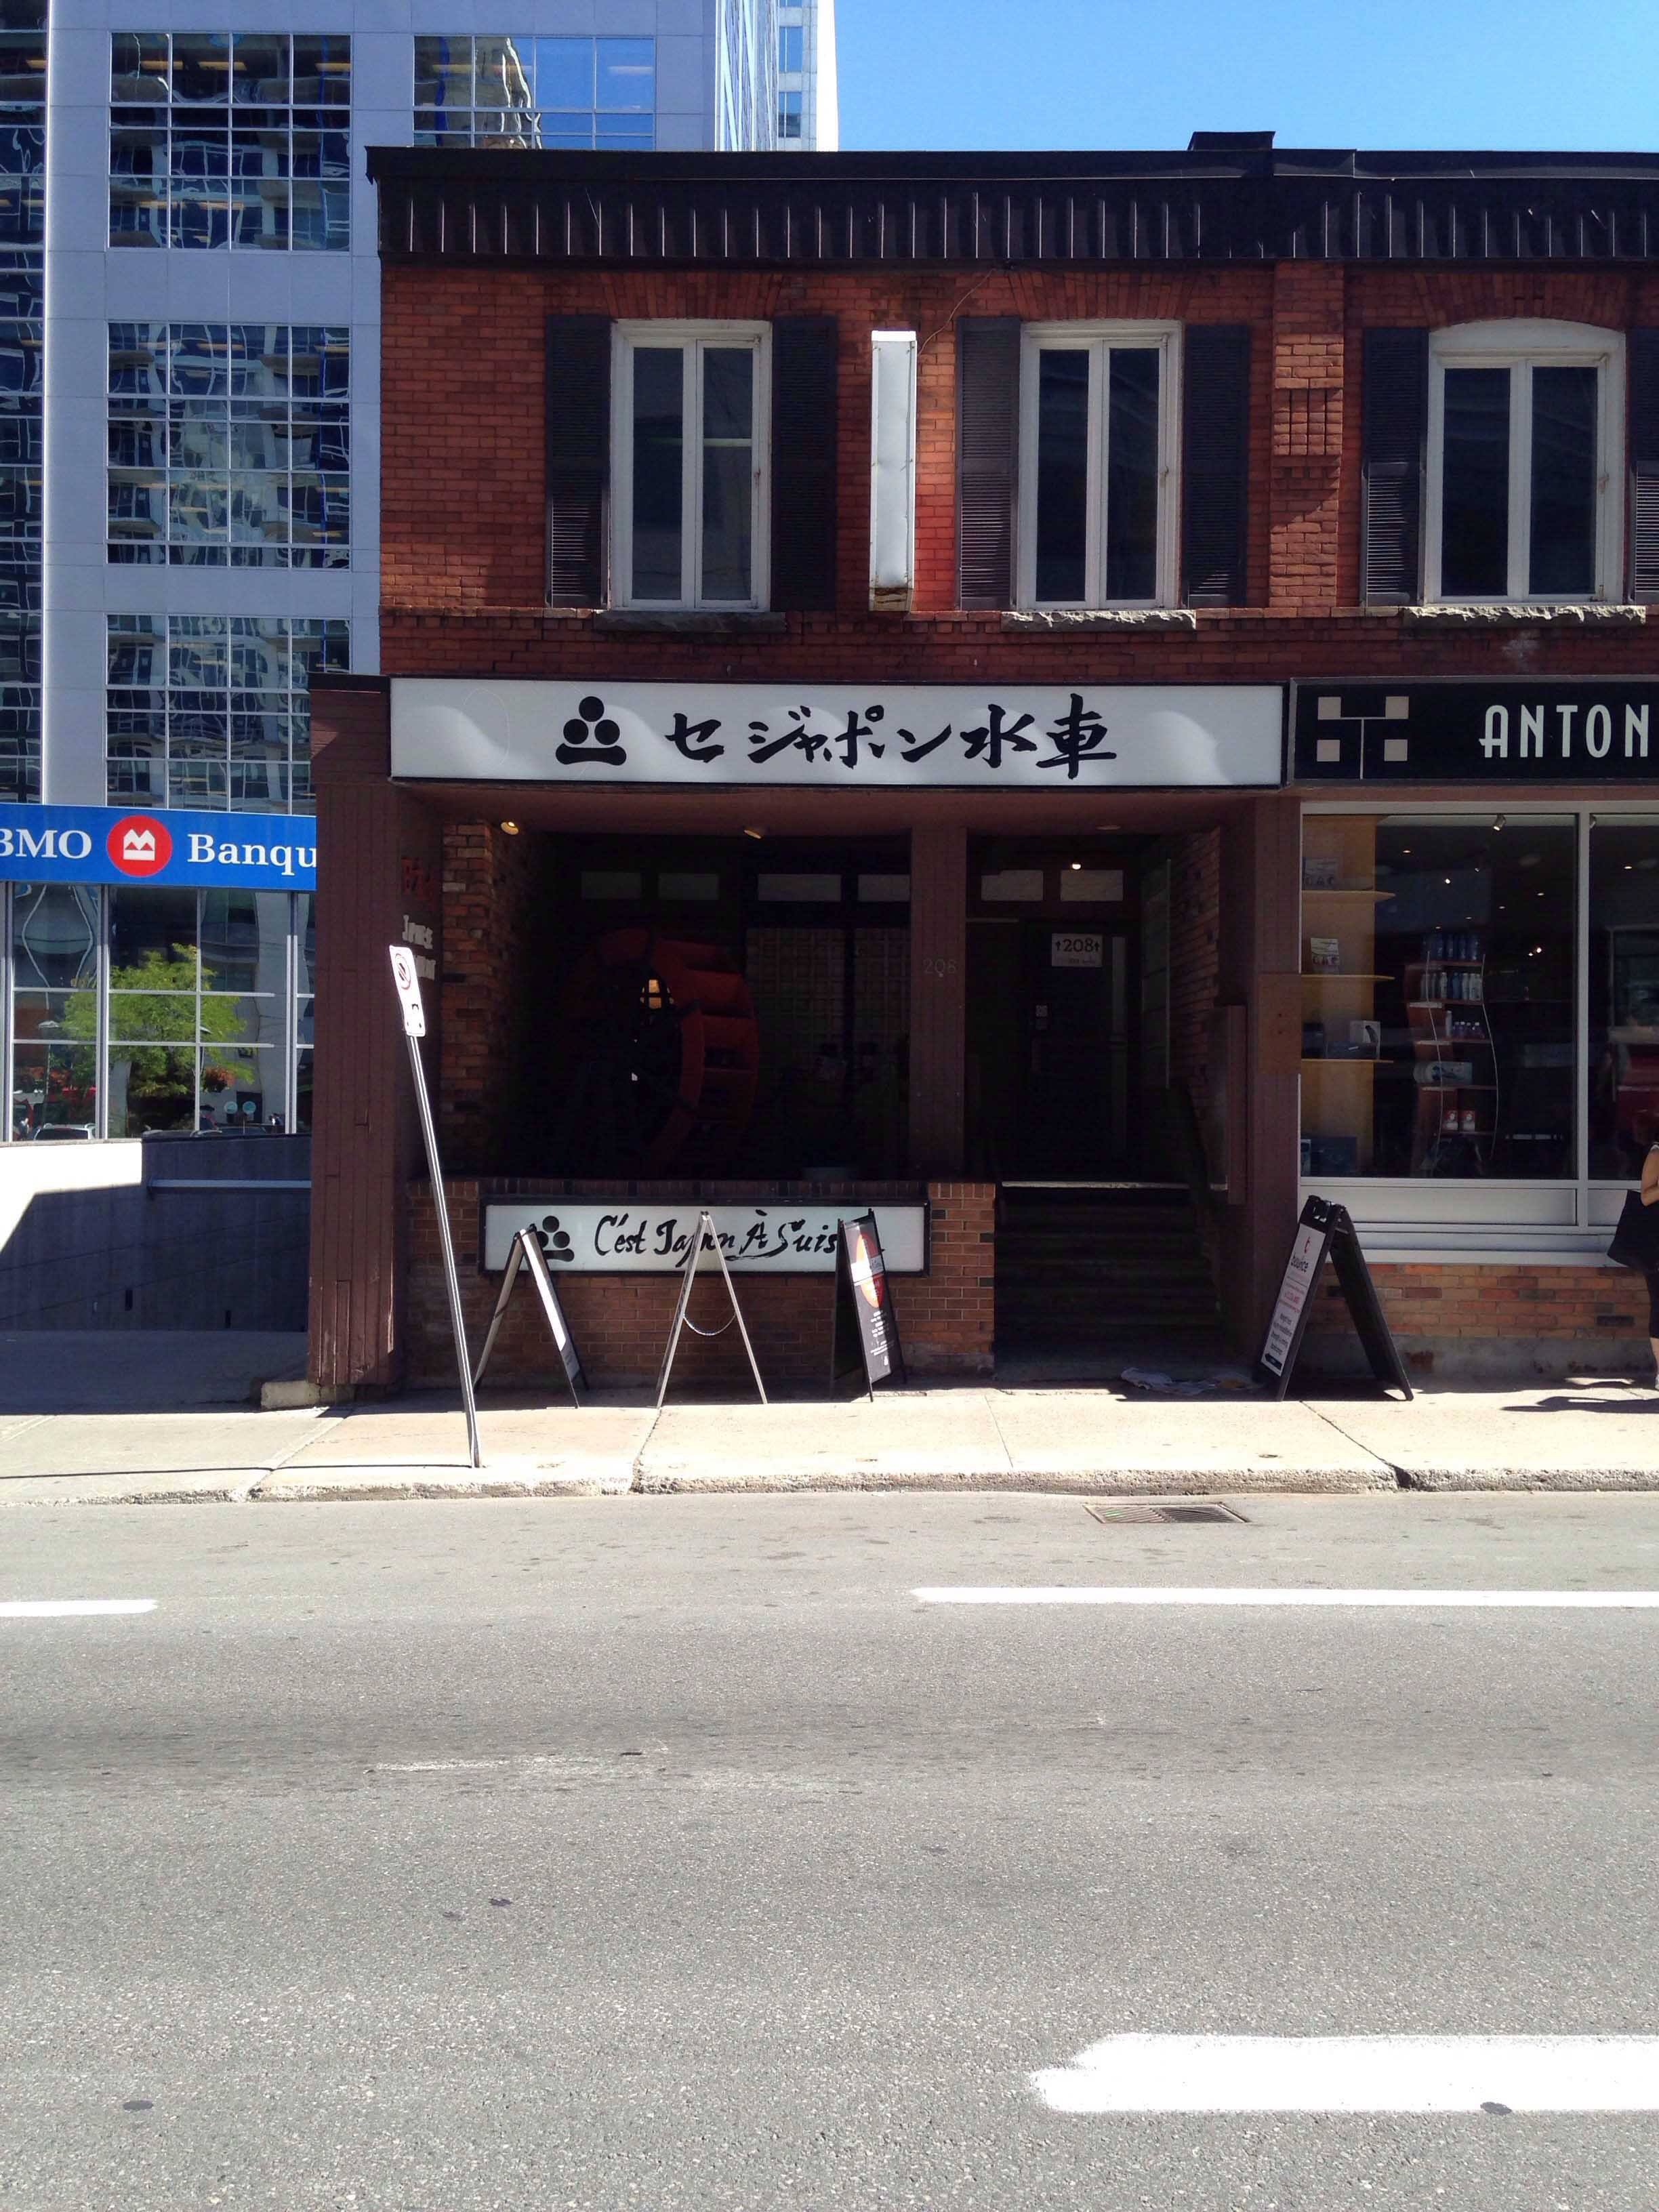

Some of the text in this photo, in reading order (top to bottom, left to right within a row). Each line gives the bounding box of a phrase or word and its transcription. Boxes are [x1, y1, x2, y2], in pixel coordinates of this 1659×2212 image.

[665, 693, 1118, 780] セジャポン水車
[1479, 704, 1650, 758] ANTON
[0, 829, 316, 876] BMO Banqu
[594, 1212, 647, 1256] C'est
[739, 1209, 768, 1255] À
